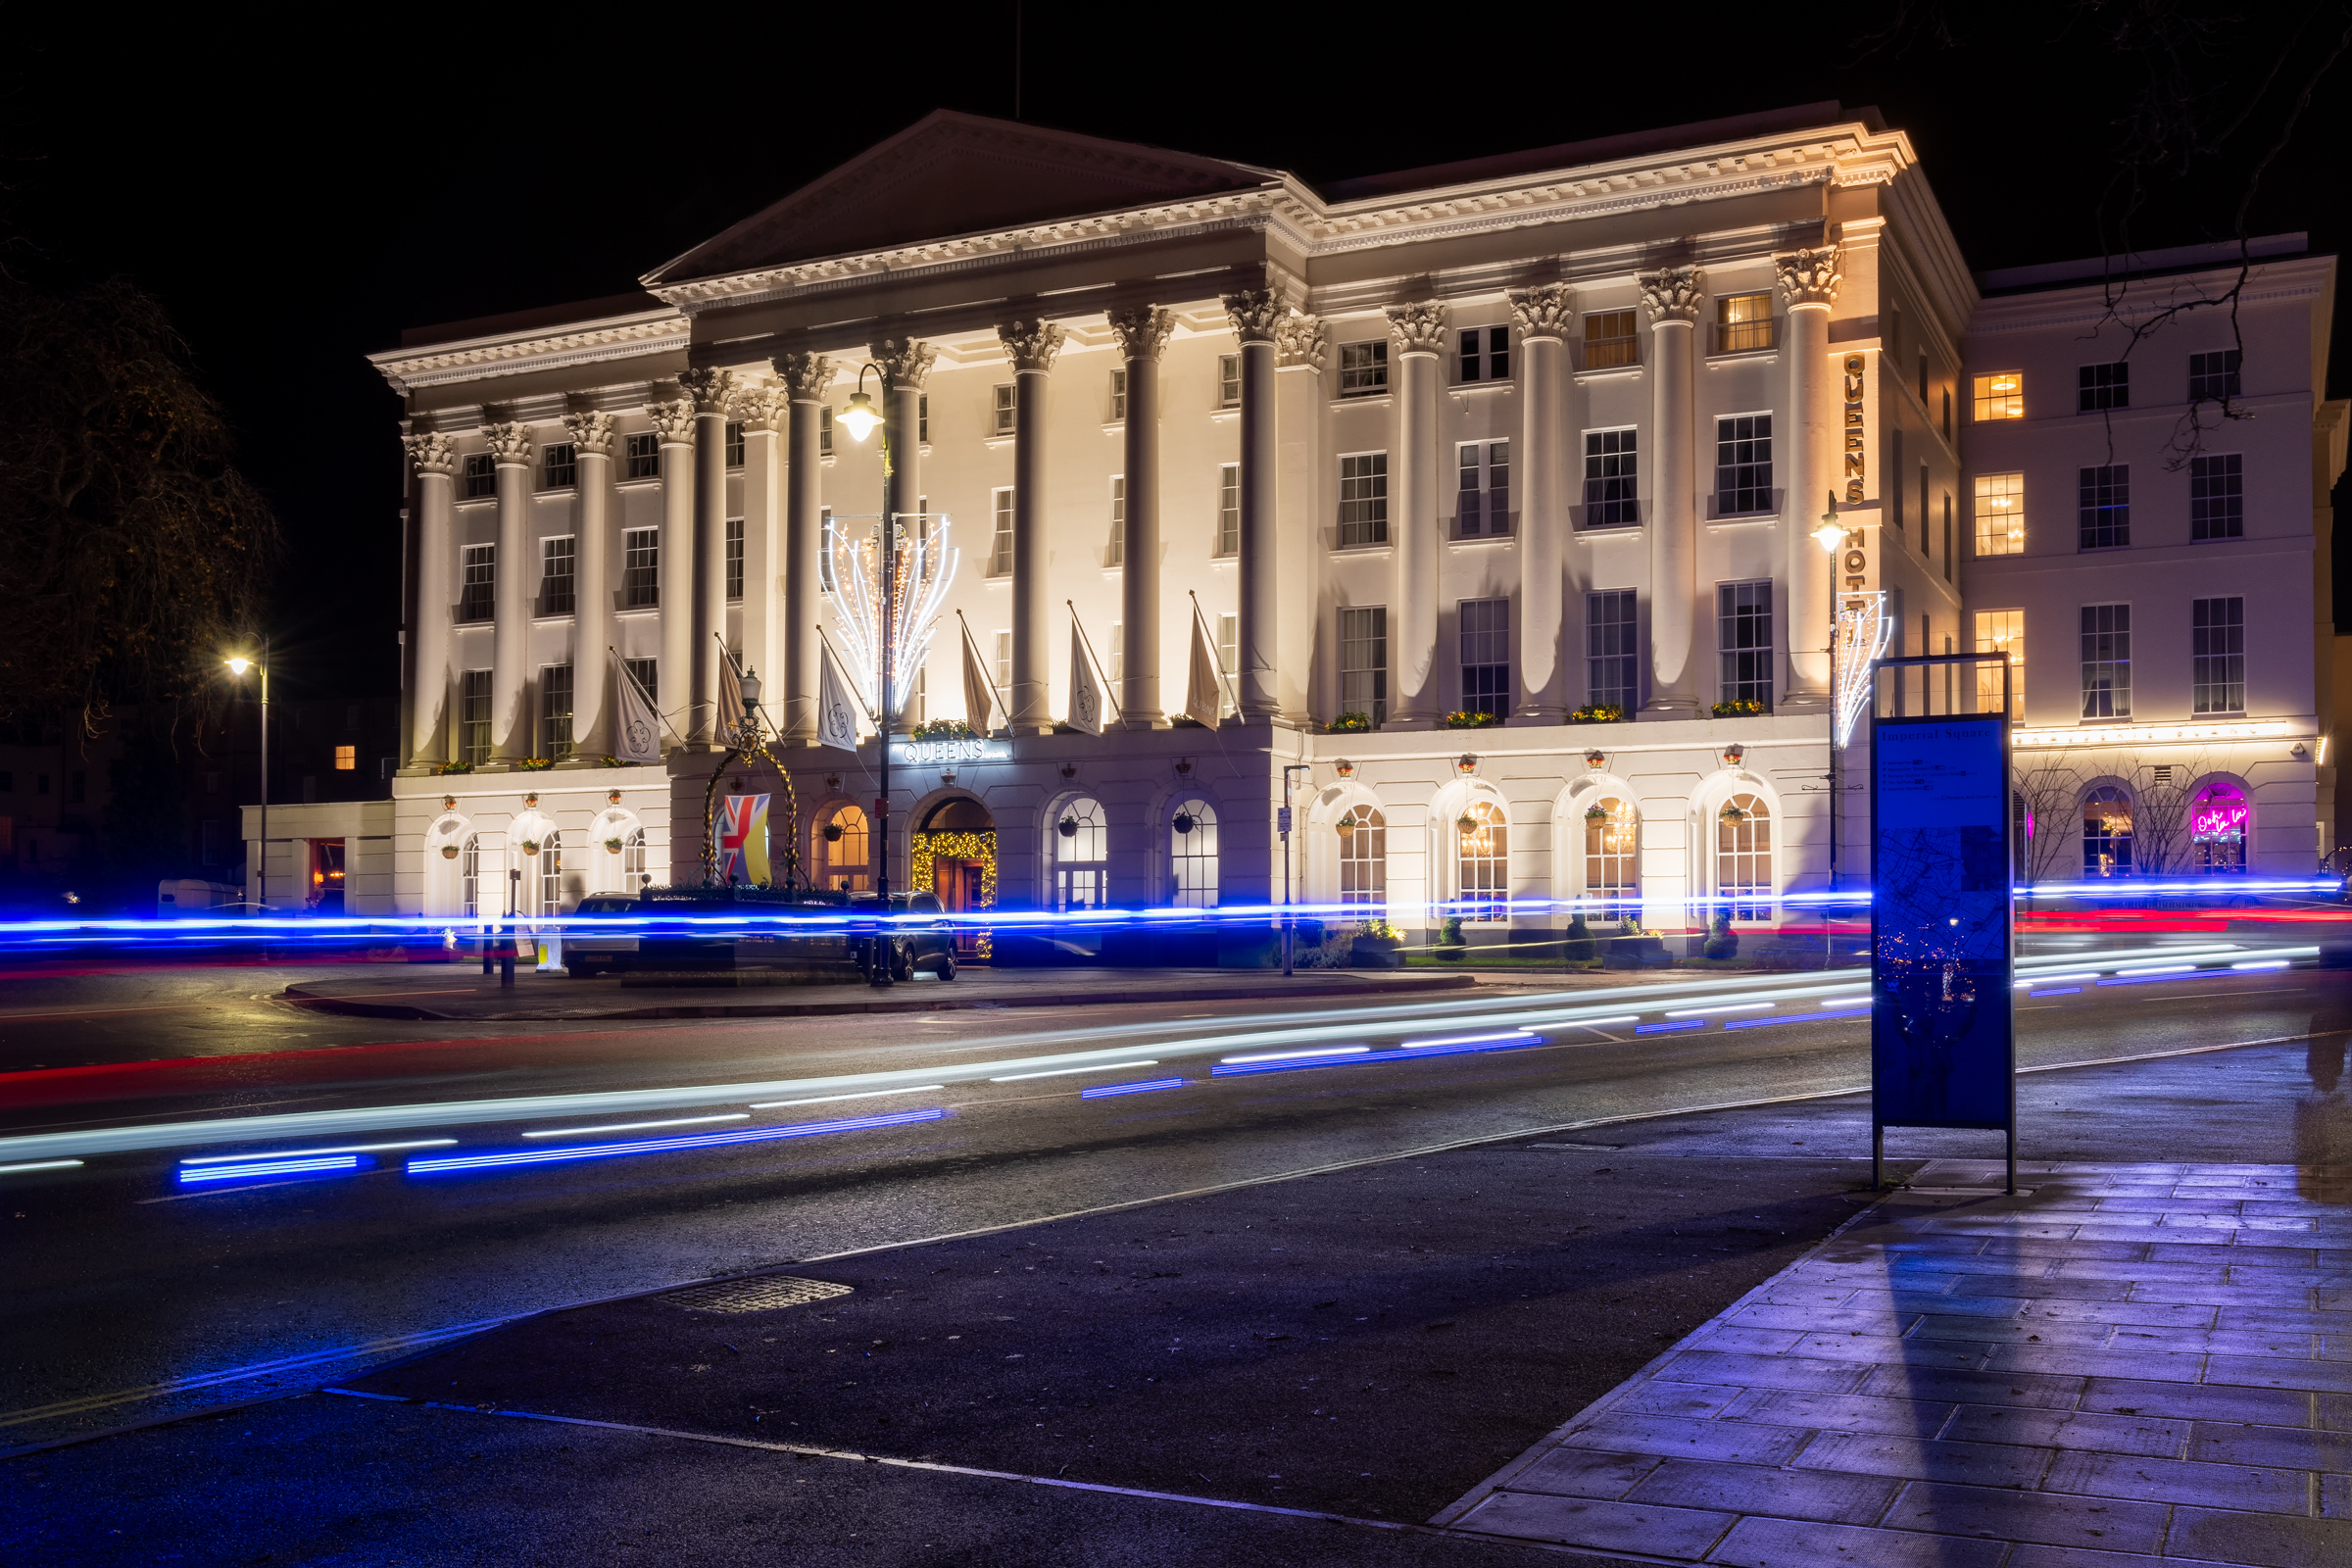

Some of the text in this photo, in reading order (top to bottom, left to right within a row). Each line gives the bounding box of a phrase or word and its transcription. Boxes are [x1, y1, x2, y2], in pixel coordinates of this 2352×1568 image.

[1882, 728, 1991, 742] Imperial Square
[904, 740, 984, 762] QUEENS
[2198, 809, 2246, 832] Ooh la la
